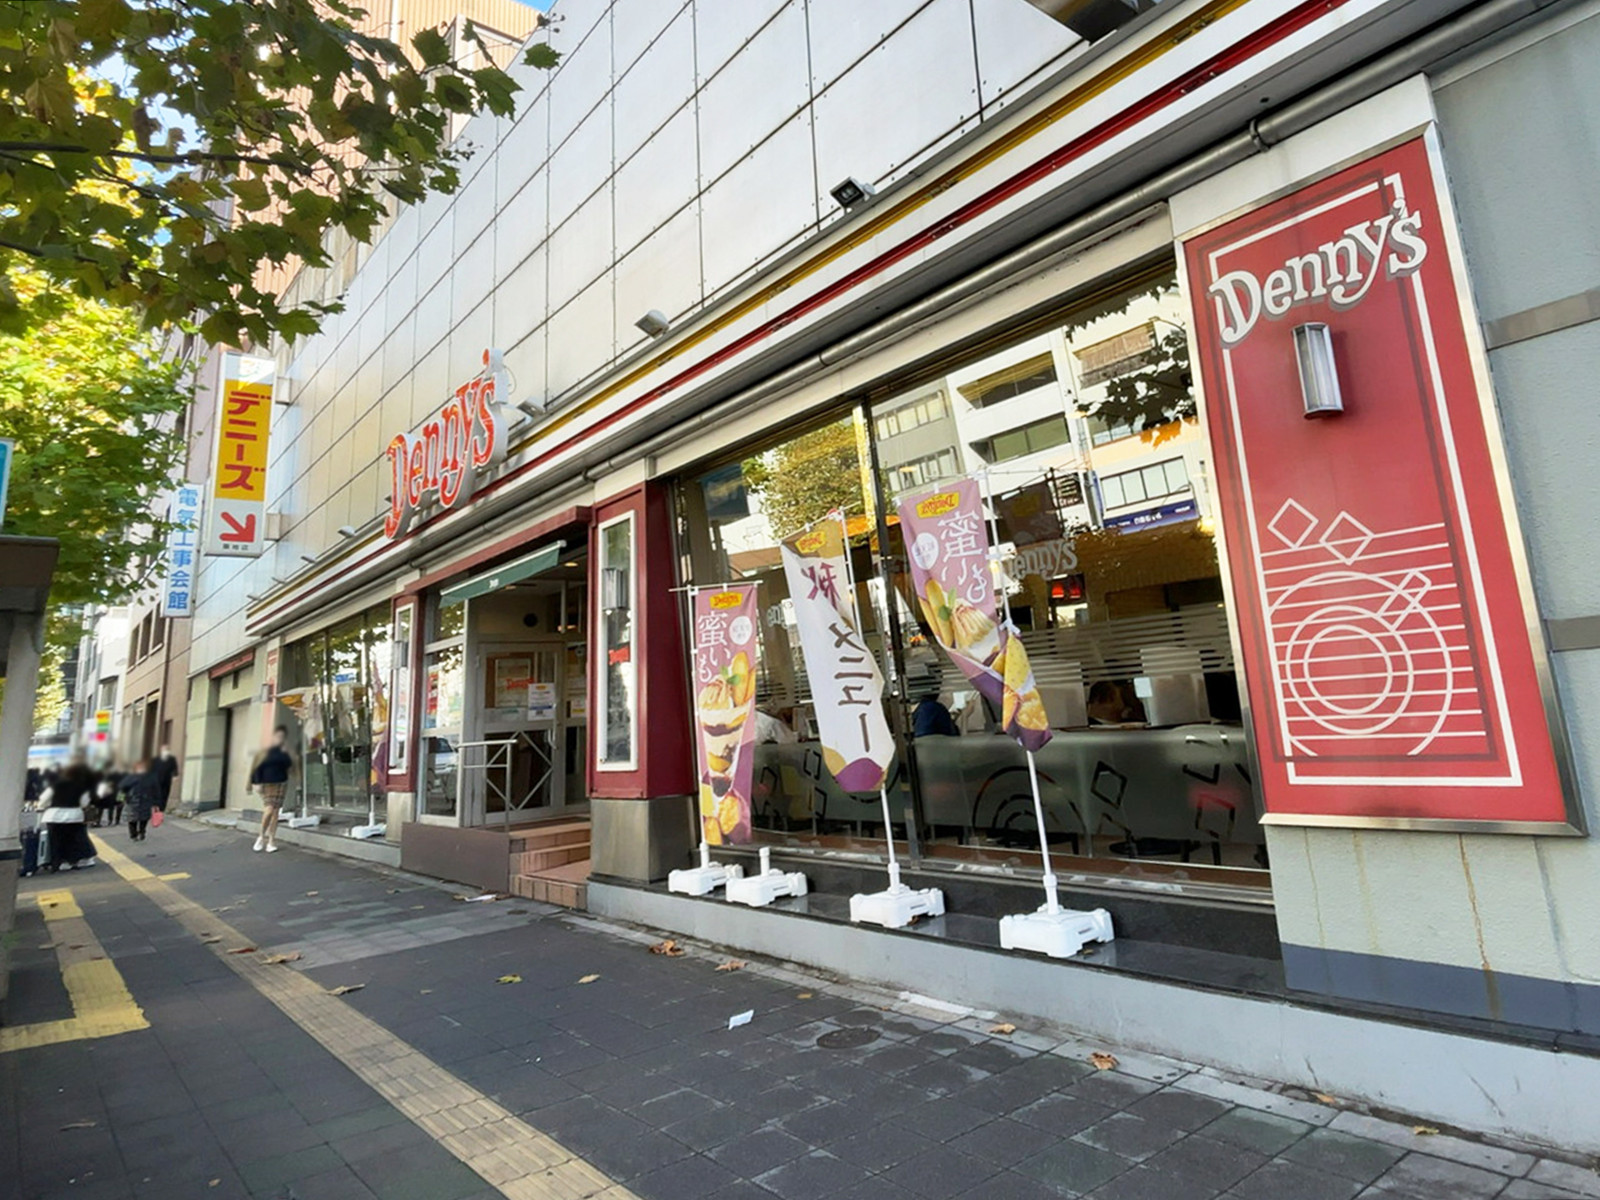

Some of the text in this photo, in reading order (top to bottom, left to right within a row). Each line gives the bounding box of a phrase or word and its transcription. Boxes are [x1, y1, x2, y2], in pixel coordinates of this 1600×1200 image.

[1208, 199, 1428, 343] Denny's
[221, 390, 272, 491] デニーズ
[384, 348, 495, 538] Denny's
[168, 487, 198, 609] 電気工事会館
[698, 611, 731, 683] 蜜いも
